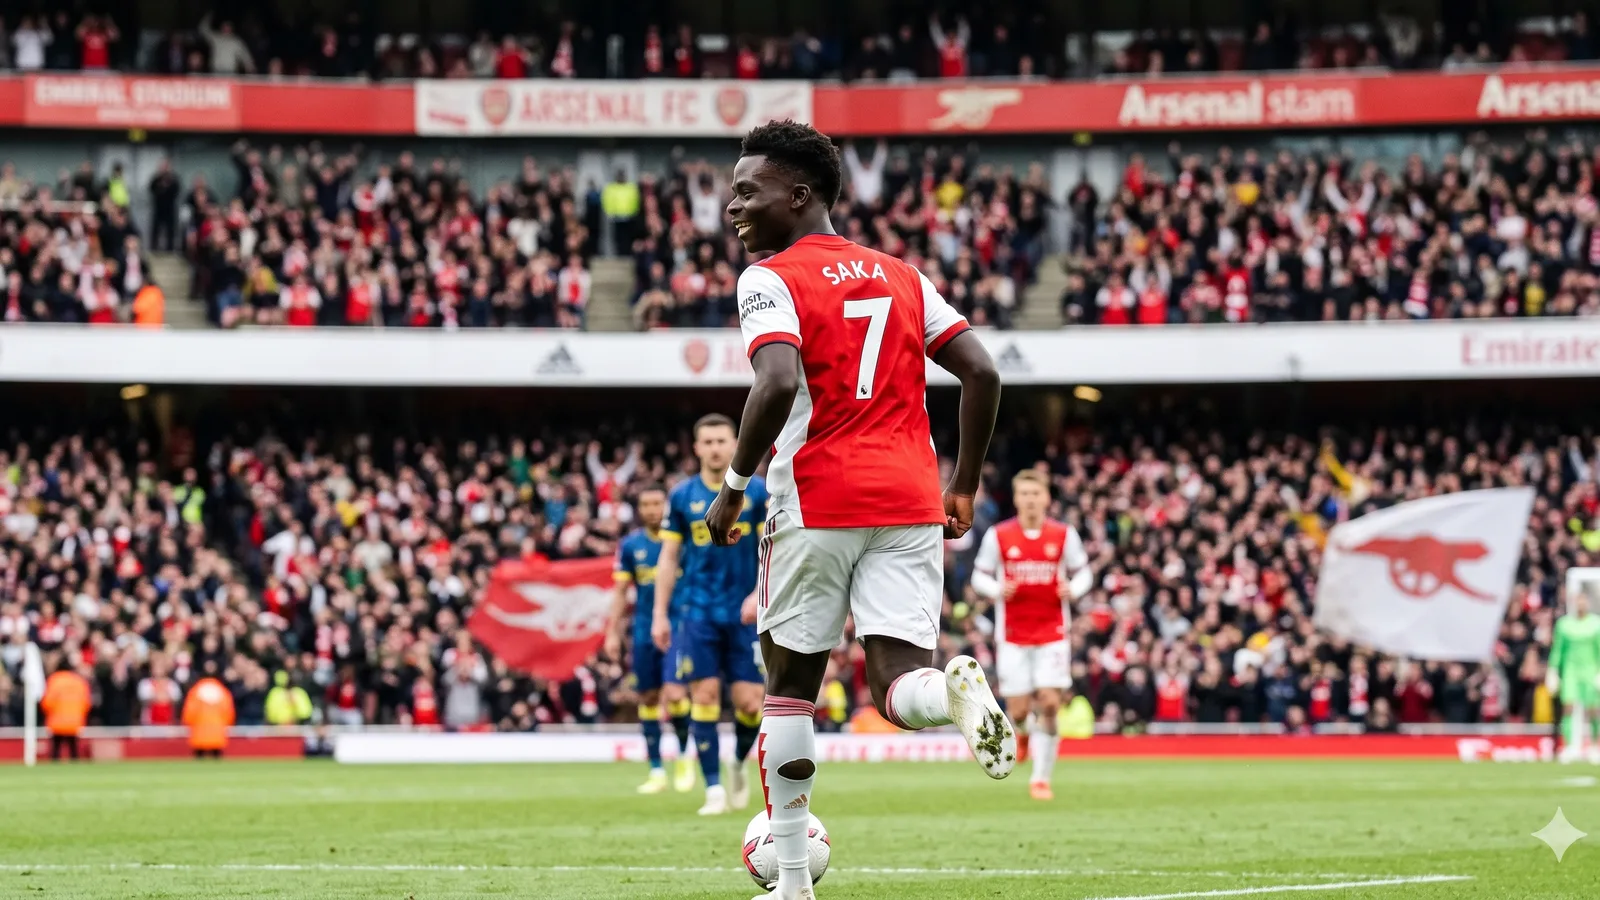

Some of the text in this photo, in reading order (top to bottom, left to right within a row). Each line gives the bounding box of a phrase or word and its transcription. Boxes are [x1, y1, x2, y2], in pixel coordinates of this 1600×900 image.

[519, 89, 699, 125] ARSENAL FC
[1119, 78, 1263, 126] Arsenal
[822, 260, 888, 285] SAKA
[740, 292, 762, 310] VISIT
[843, 296, 893, 400] 7
